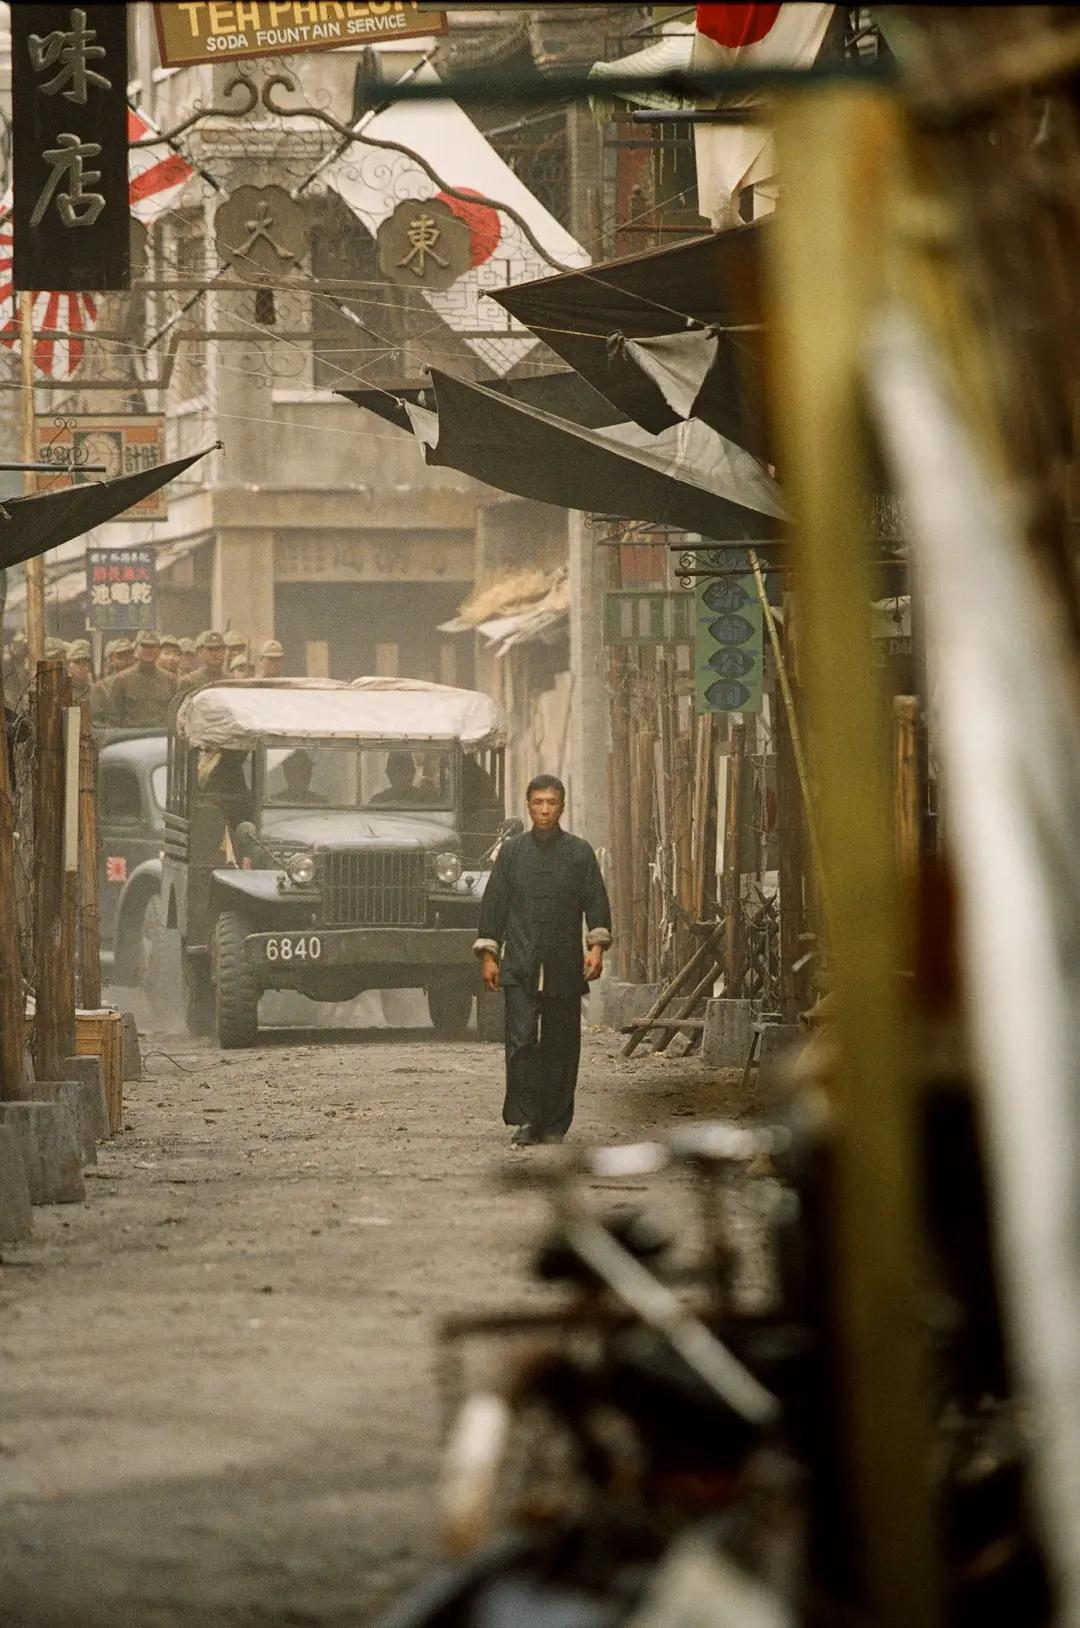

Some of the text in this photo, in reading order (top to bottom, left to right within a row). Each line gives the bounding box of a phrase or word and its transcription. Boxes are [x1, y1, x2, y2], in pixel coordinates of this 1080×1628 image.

[206, 13, 407, 51] SODA FOUNTAIN SERVICE
[27, 7, 112, 227] 味店
[266, 936, 321, 961] 6840
